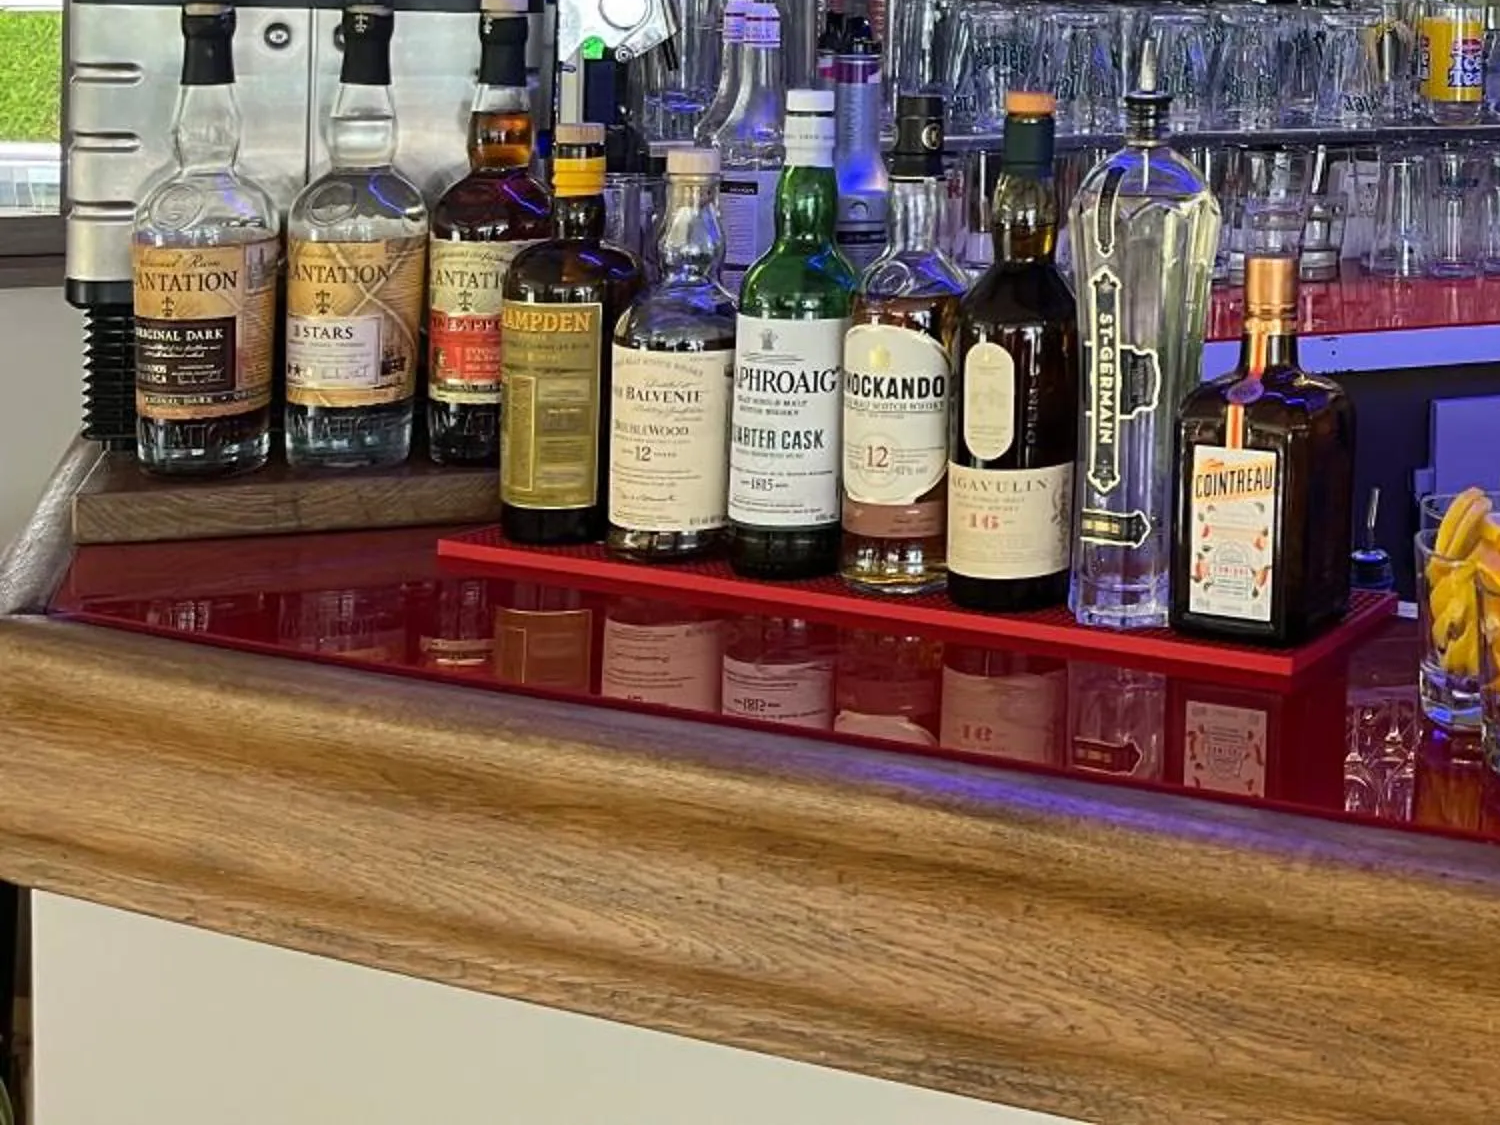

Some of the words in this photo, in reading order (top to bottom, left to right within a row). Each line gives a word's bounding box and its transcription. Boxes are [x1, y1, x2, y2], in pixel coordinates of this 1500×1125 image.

[135, 271, 237, 292] ANTATION
[290, 264, 390, 284] ANTATION
[185, 328, 224, 341] DARK
[302, 325, 353, 340] STARS
[737, 366, 838, 394] PHROAIG
[848, 373, 946, 400] OCKANDO
[1099, 312, 1114, 445] ST-GERMAIN
[736, 426, 777, 450] ARTER
[781, 428, 825, 450] CASK
[635, 446, 652, 462] 12
[867, 445, 890, 468] 12
[953, 476, 1049, 493] GAVULIN
[1195, 464, 1273, 499] COINTREAU
